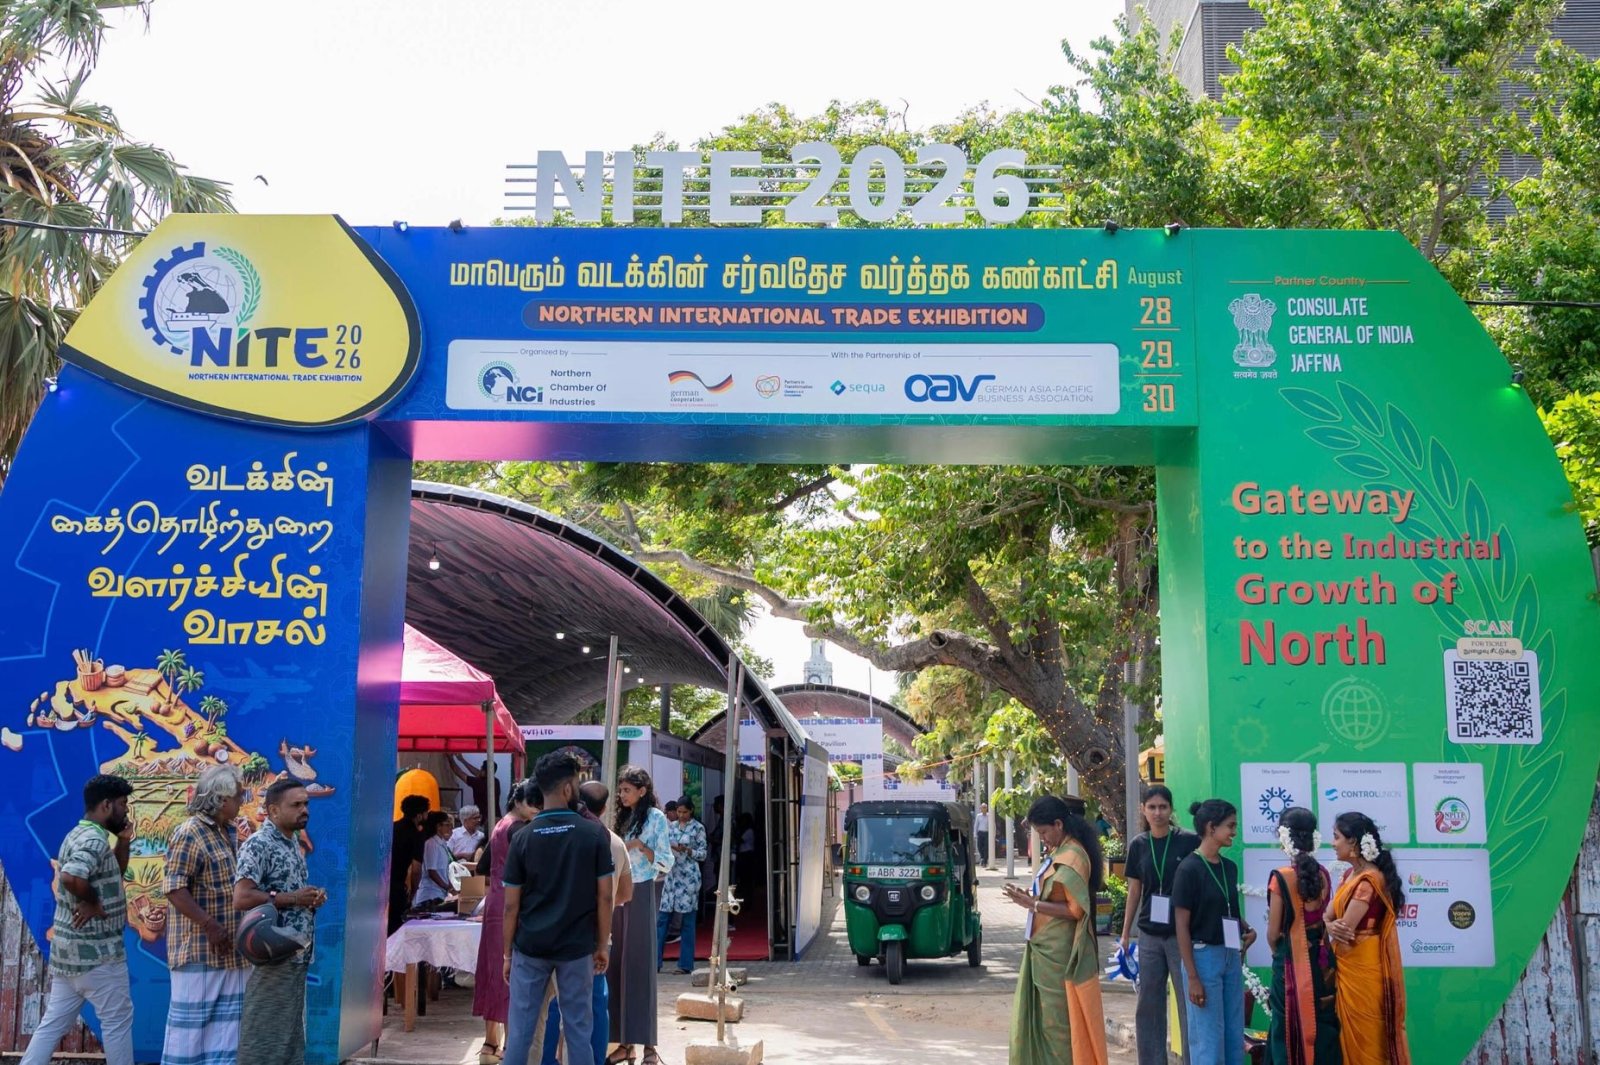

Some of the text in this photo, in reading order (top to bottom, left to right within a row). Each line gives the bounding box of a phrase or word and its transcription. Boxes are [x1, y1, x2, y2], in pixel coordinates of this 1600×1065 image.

[535, 141, 1031, 225] NITE 2026
[450, 253, 1118, 295] மாபெரும் வடக்கின் சர்வதேச வர்த்தக கண்காட்சி
[1128, 267, 1182, 288] August
[1274, 276, 1366, 287] Partner Country
[539, 305, 1028, 327] NORTHERN INTERNATIONAL TRADE EXHIBITION
[1140, 297, 1171, 324] 28
[1288, 298, 1368, 316] CONSULATE
[336, 324, 362, 345] 20
[1289, 326, 1414, 344] GENERAL OF INDIA
[335, 349, 361, 369] 26
[519, 348, 569, 358] Organized by
[831, 351, 921, 361] With the Partnership of
[1141, 341, 1173, 368] 29
[1291, 354, 1342, 372] JAFFNA
[188, 373, 230, 381] NORTHERN
[231, 373, 290, 381] INTERNATIONAL
[319, 374, 362, 382] EXHIBITION
[550, 369, 592, 378] Northern
[549, 383, 607, 392] Chamber Of
[670, 389, 700, 399] german
[849, 384, 886, 394] sequa
[985, 385, 1093, 393] GERMAN ASIA-PACIFIC
[549, 398, 596, 406] Industries
[977, 394, 1094, 403] BUSINESS ASSOCIATION
[1143, 384, 1175, 412] 30
[185, 451, 334, 507] வடக்கின்
[1232, 482, 1415, 523] Gateway
[51, 500, 334, 556] கைத்தொழிற்துறை
[1233, 533, 1501, 560] to the Industrial
[88, 553, 328, 617] வளர்ச்சியின்
[1235, 572, 1459, 604] Growth of
[183, 606, 327, 646] வாசல்
[1464, 619, 1514, 636] SCAN
[1239, 617, 1387, 666] North
[878, 868, 895, 877] ABR
[898, 868, 920, 877] 3221
